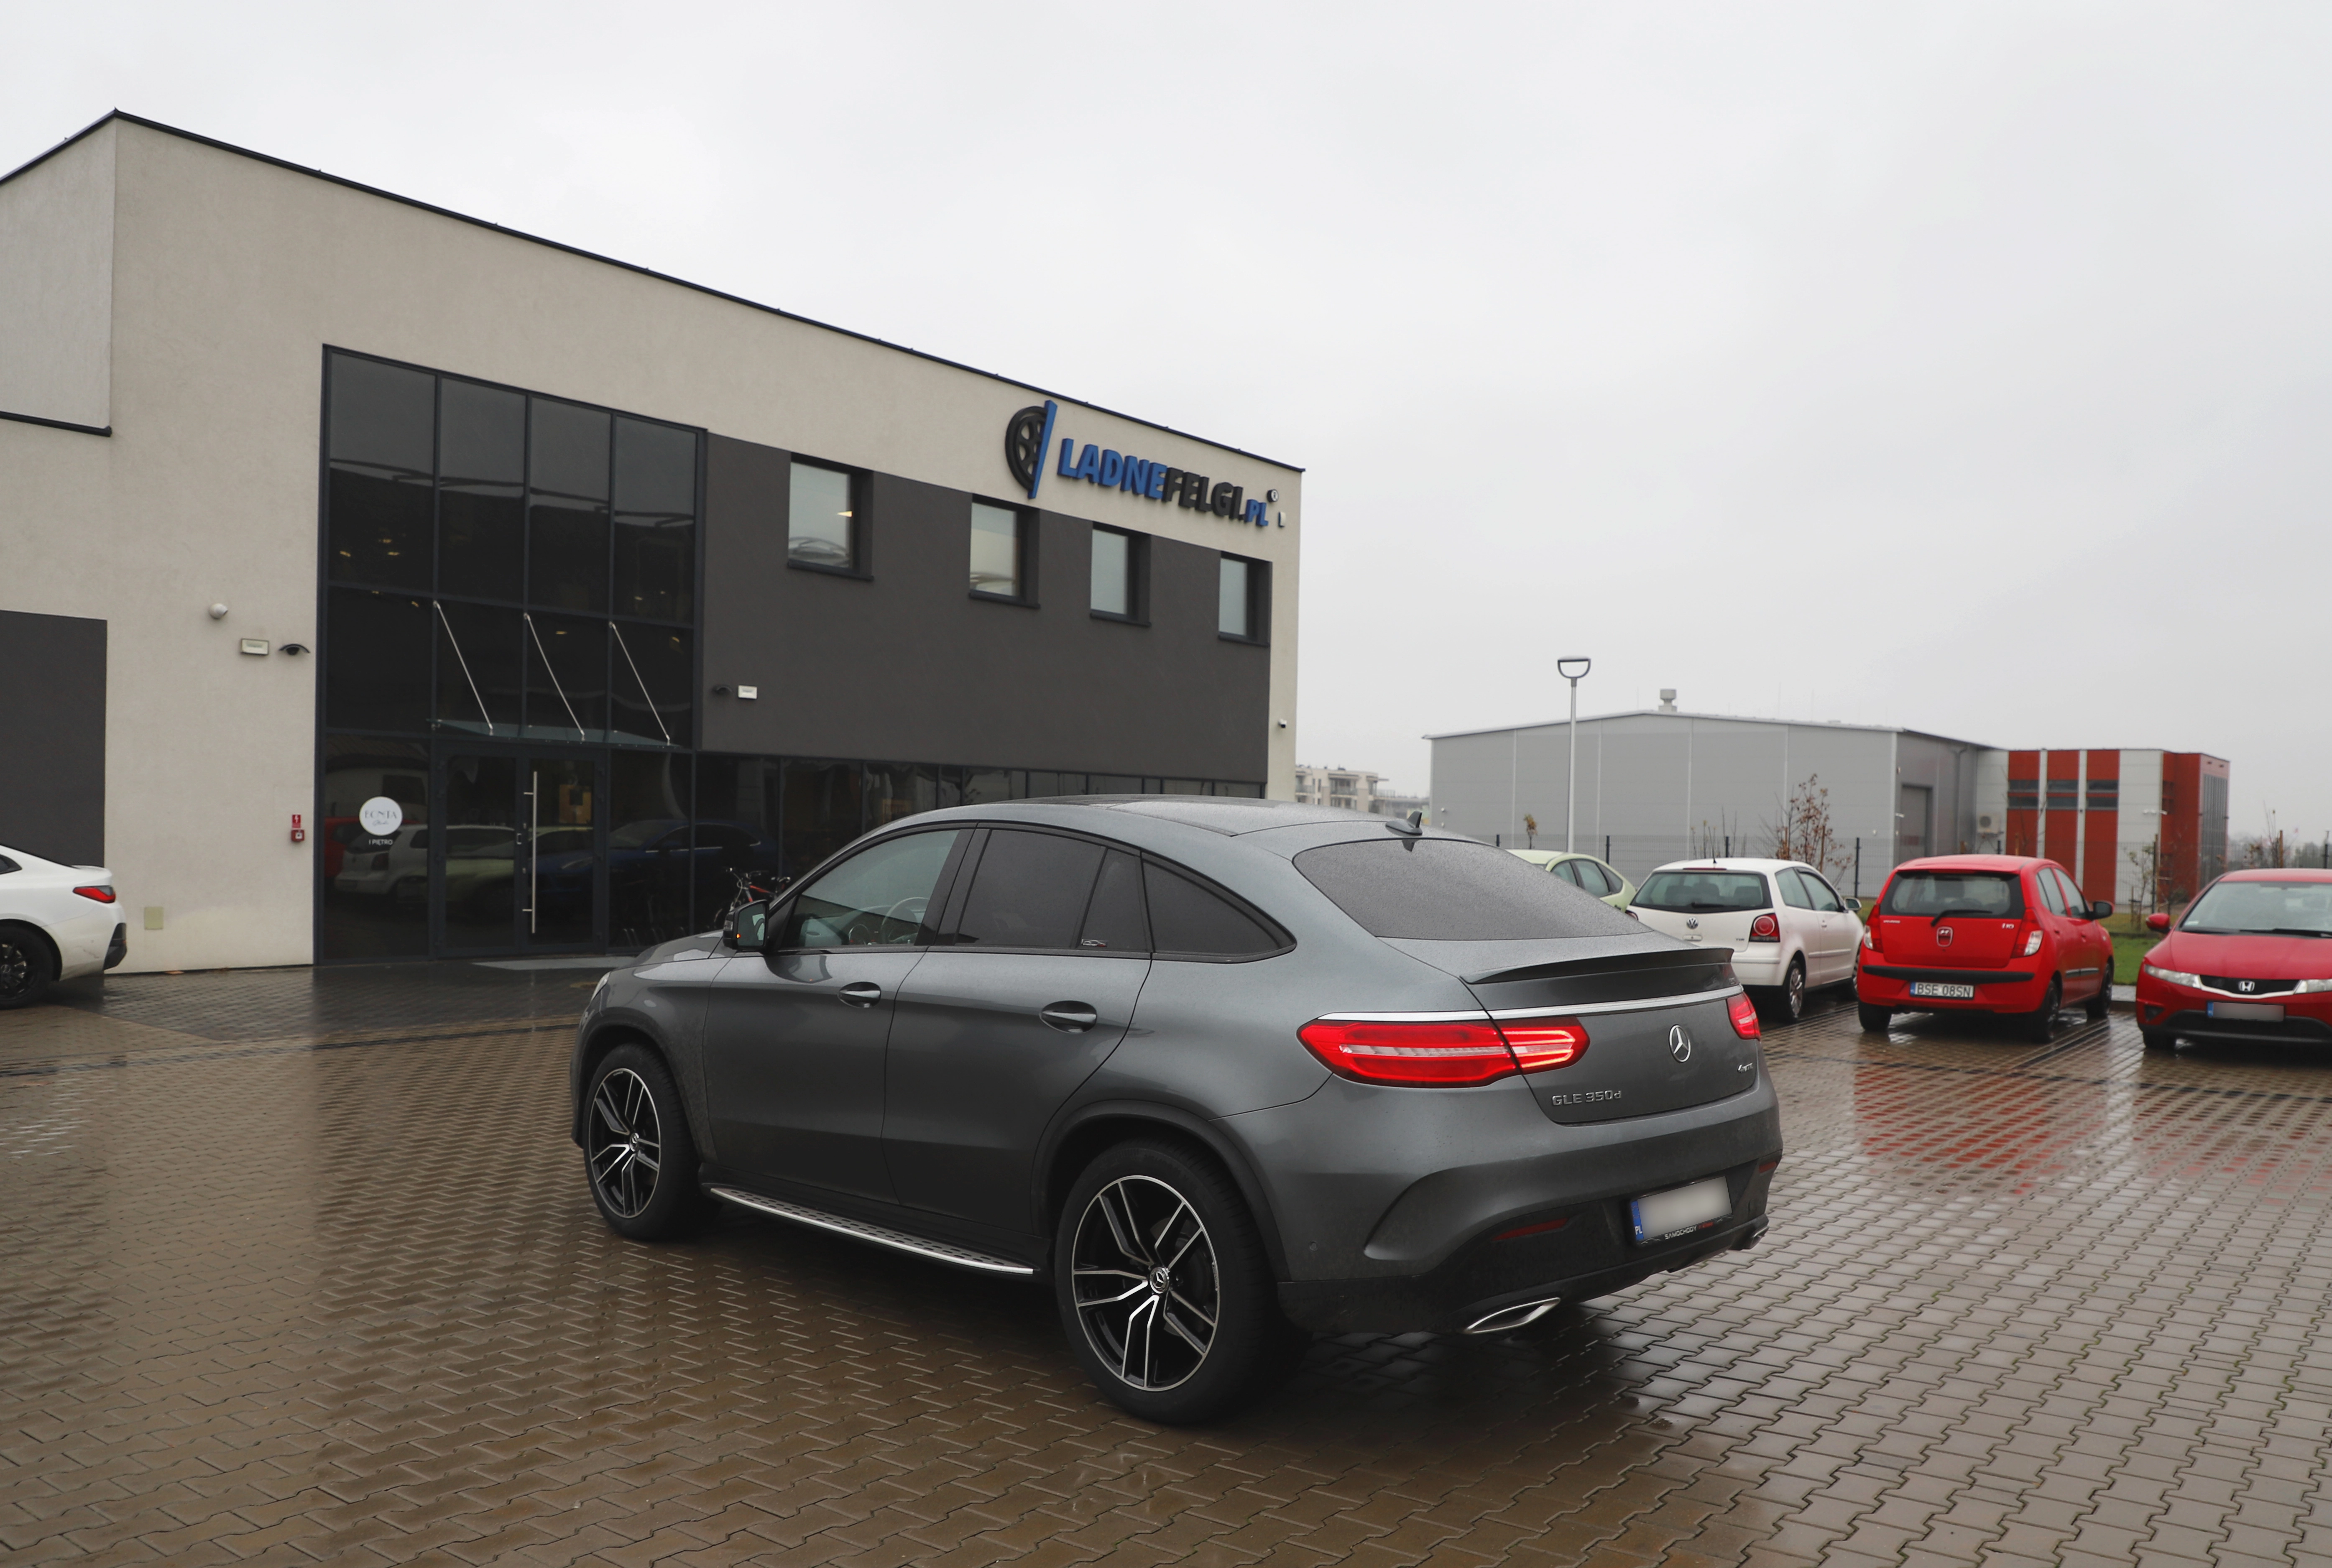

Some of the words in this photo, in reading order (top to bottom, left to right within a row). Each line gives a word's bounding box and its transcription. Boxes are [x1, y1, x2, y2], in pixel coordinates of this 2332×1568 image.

[1057, 438, 1269, 527] LADNEFELGI.PL
[1917, 983, 1939, 995] BSE
[1942, 985, 1971, 998] 08SN
[1552, 1093, 1583, 1106] GLE
[1586, 1090, 1622, 1102] 350d
[1635, 1225, 1643, 1235] PL
[1664, 1225, 1697, 1240] SAMOCHODY
